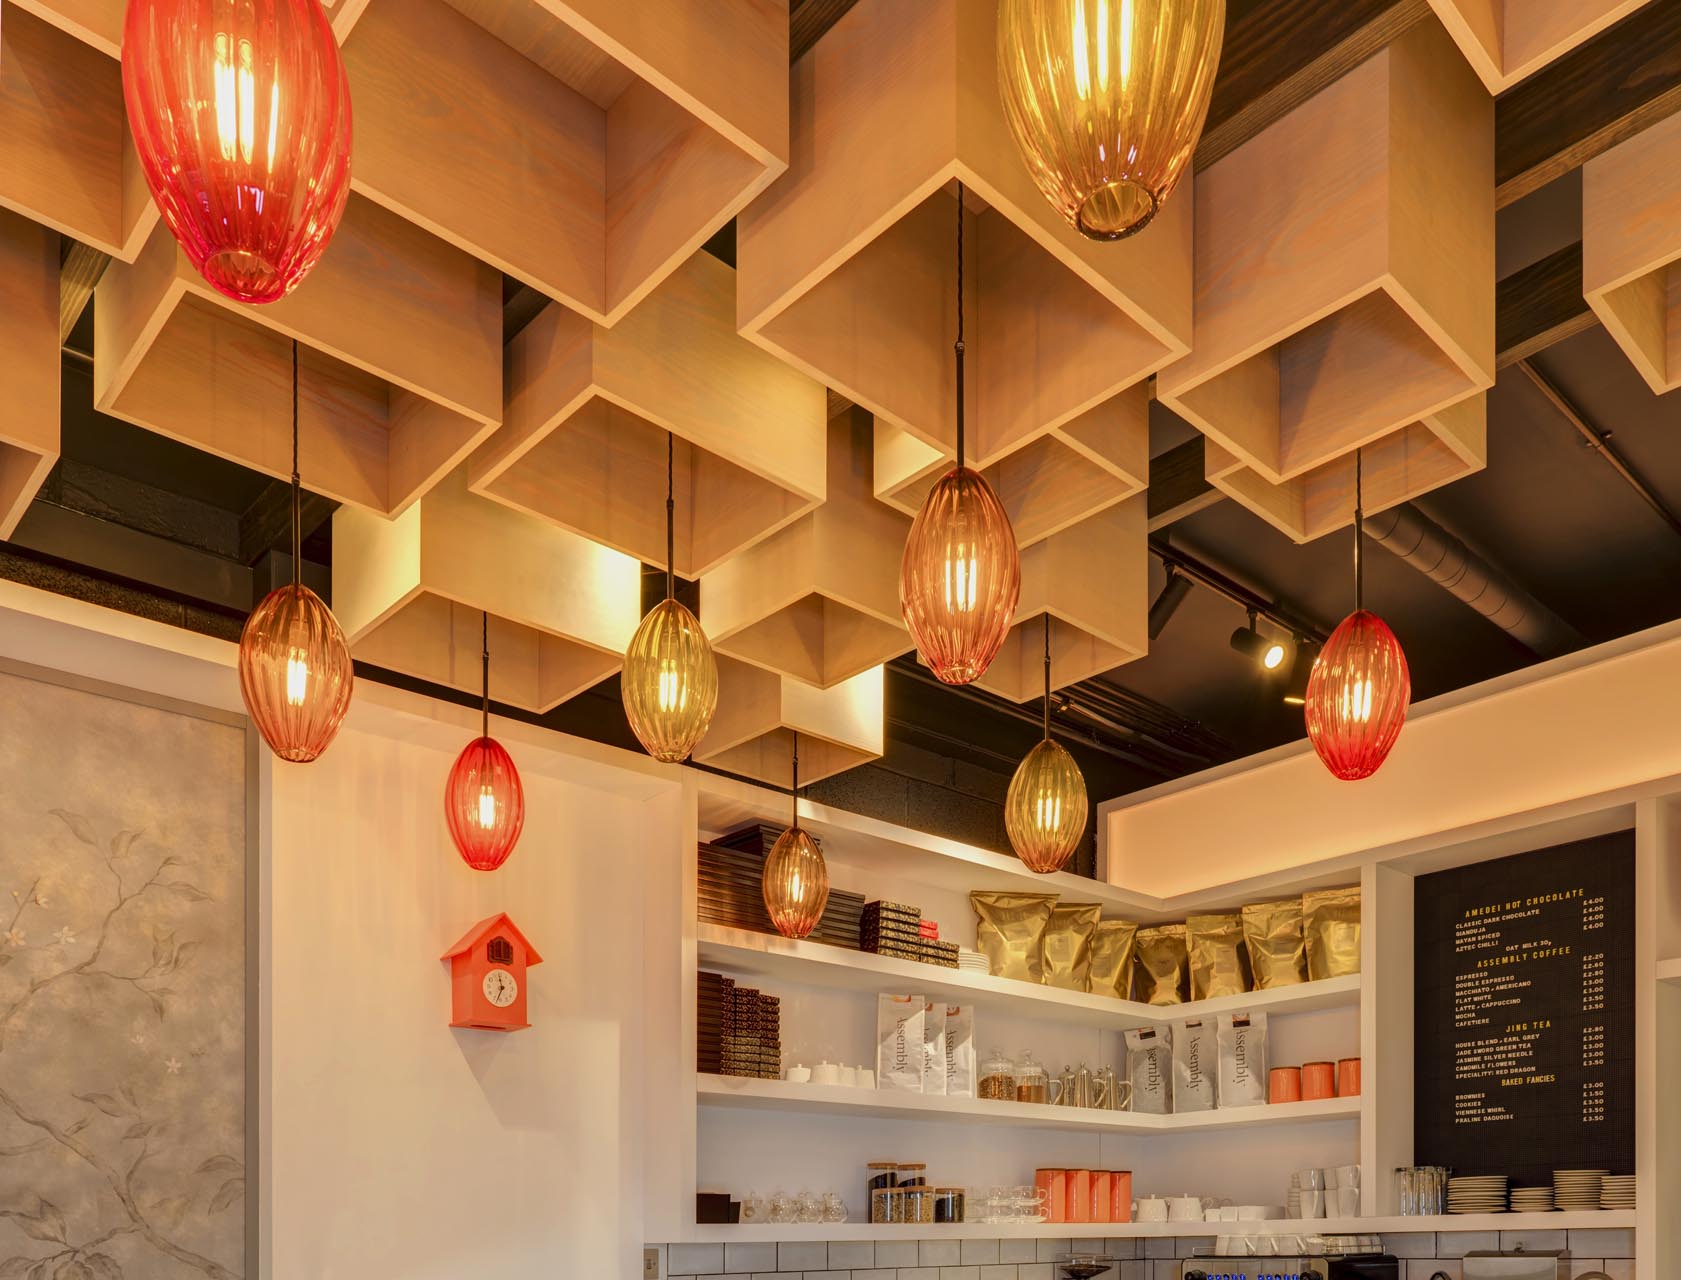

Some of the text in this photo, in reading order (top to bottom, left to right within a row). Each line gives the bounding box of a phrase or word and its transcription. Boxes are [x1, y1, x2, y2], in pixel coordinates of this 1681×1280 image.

[1456, 920, 1482, 929] CLASSIC
[1502, 909, 1540, 920] CHOCOLATE
[1583, 897, 1603, 905] £4.00
[1465, 888, 1584, 918] AMEDEI HOT CHOCOLATE
[1456, 927, 1486, 936] GIANDUJA
[1456, 944, 1476, 952] AZTEC
[1583, 922, 1603, 930] £4.00
[1478, 932, 1500, 940] SPICED
[1583, 914, 1603, 922] £4.00
[1477, 946, 1570, 968] ASSEMBLY COFFEE
[1456, 972, 1488, 981] ESPRESSO
[1482, 976, 1515, 985] ESPRESSO
[1456, 987, 1489, 996] MACCHIATO
[1496, 981, 1531, 990] AMERICANO
[1482, 999, 1521, 1008] CAPPUCCINO
[1456, 1018, 1490, 1027] CAFETIERE
[1506, 1021, 1551, 1032] JING TEA
[892, 1017, 908, 1073] Assembly
[946, 1030, 956, 1078] Assembly
[1186, 1037, 1202, 1089] Assembly
[1233, 1029, 1248, 1084] Assembly
[1502, 1075, 1555, 1086] BAKED FANCIES
